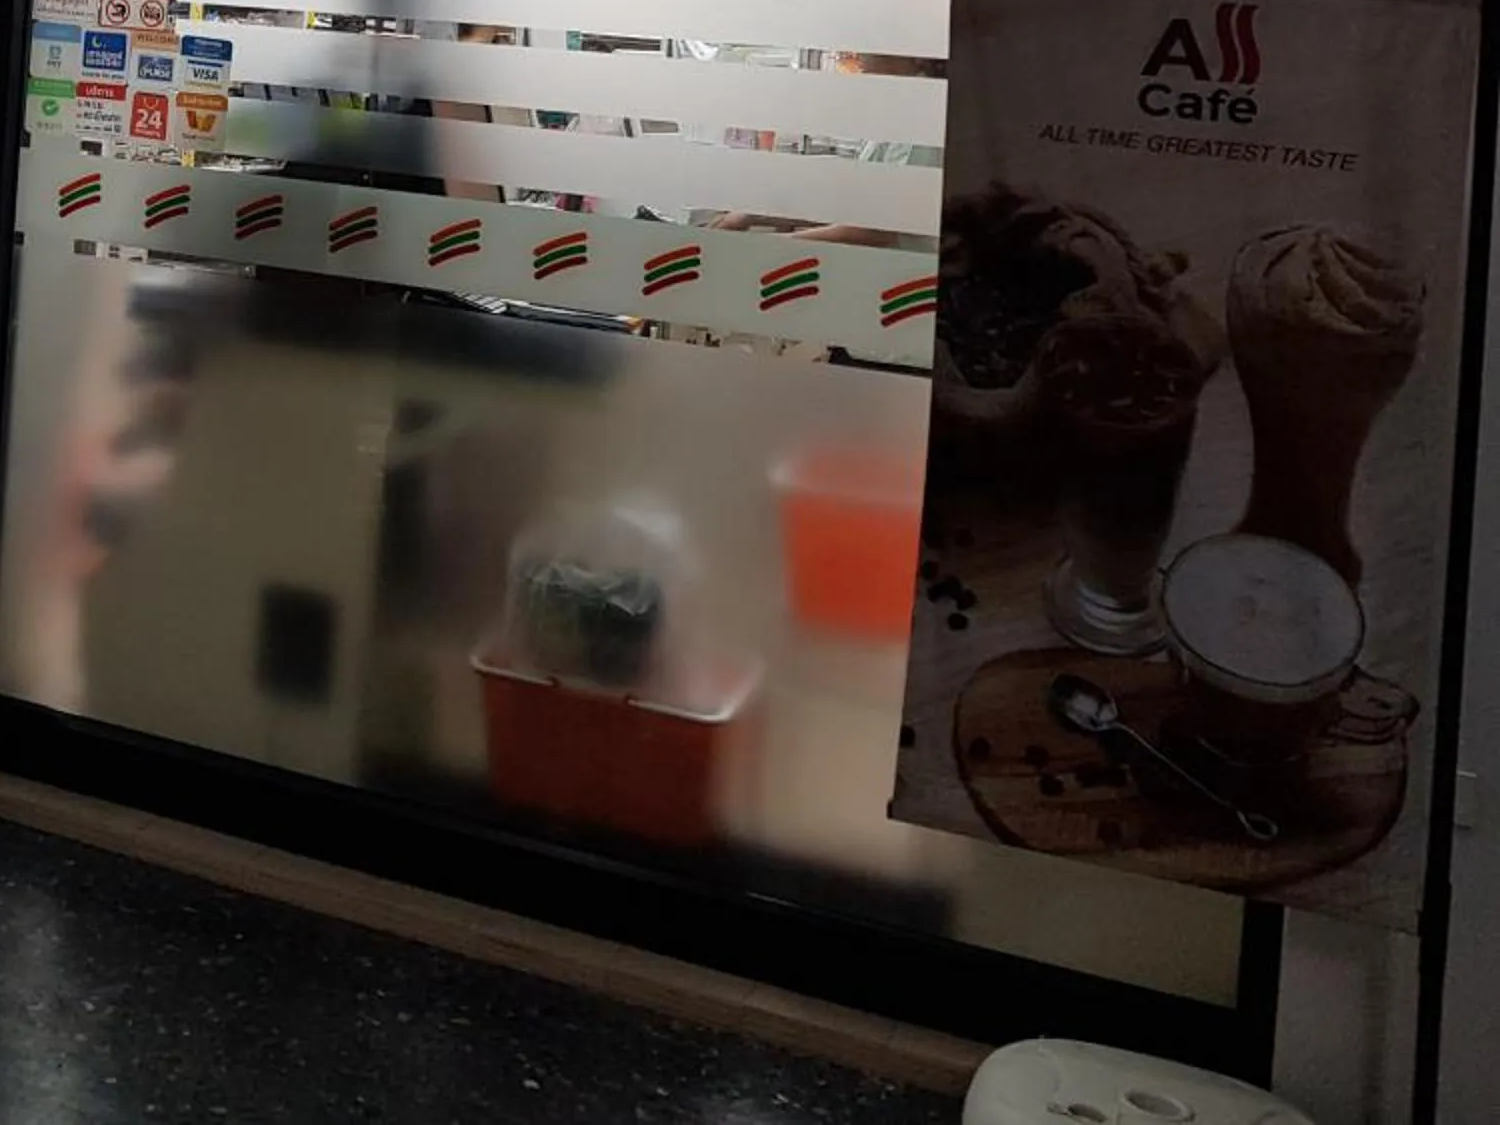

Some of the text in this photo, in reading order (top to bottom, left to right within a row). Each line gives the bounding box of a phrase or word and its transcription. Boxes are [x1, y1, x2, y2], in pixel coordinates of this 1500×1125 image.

[192, 67, 220, 82] VISA
[1137, 83, 1258, 124] Café
[136, 109, 164, 130] 24
[1038, 124, 1360, 173] ALL TIME GREATEST TASTE
